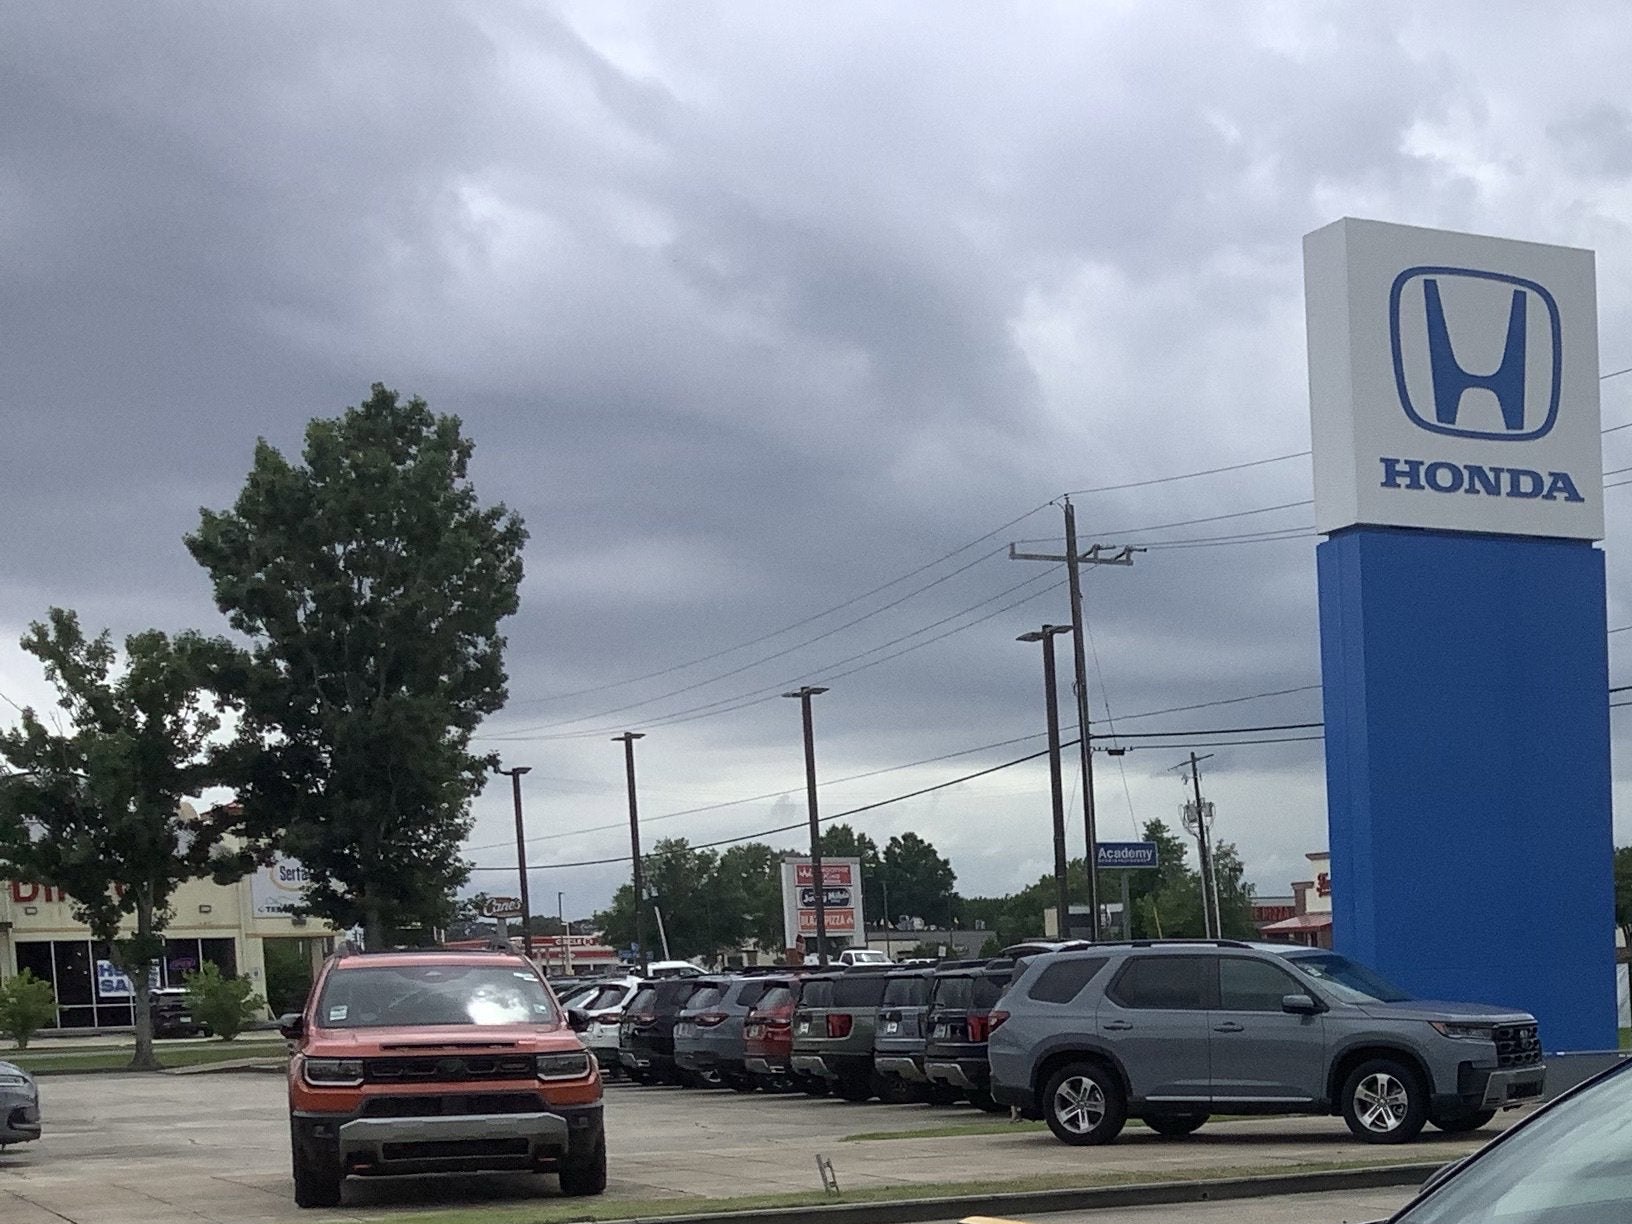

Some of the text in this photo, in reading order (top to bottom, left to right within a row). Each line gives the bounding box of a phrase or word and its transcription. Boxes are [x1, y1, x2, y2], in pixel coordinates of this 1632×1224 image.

[1379, 456, 1585, 503] HONDA
[1098, 847, 1153, 861] Academy
[483, 897, 521, 916] Cane's
